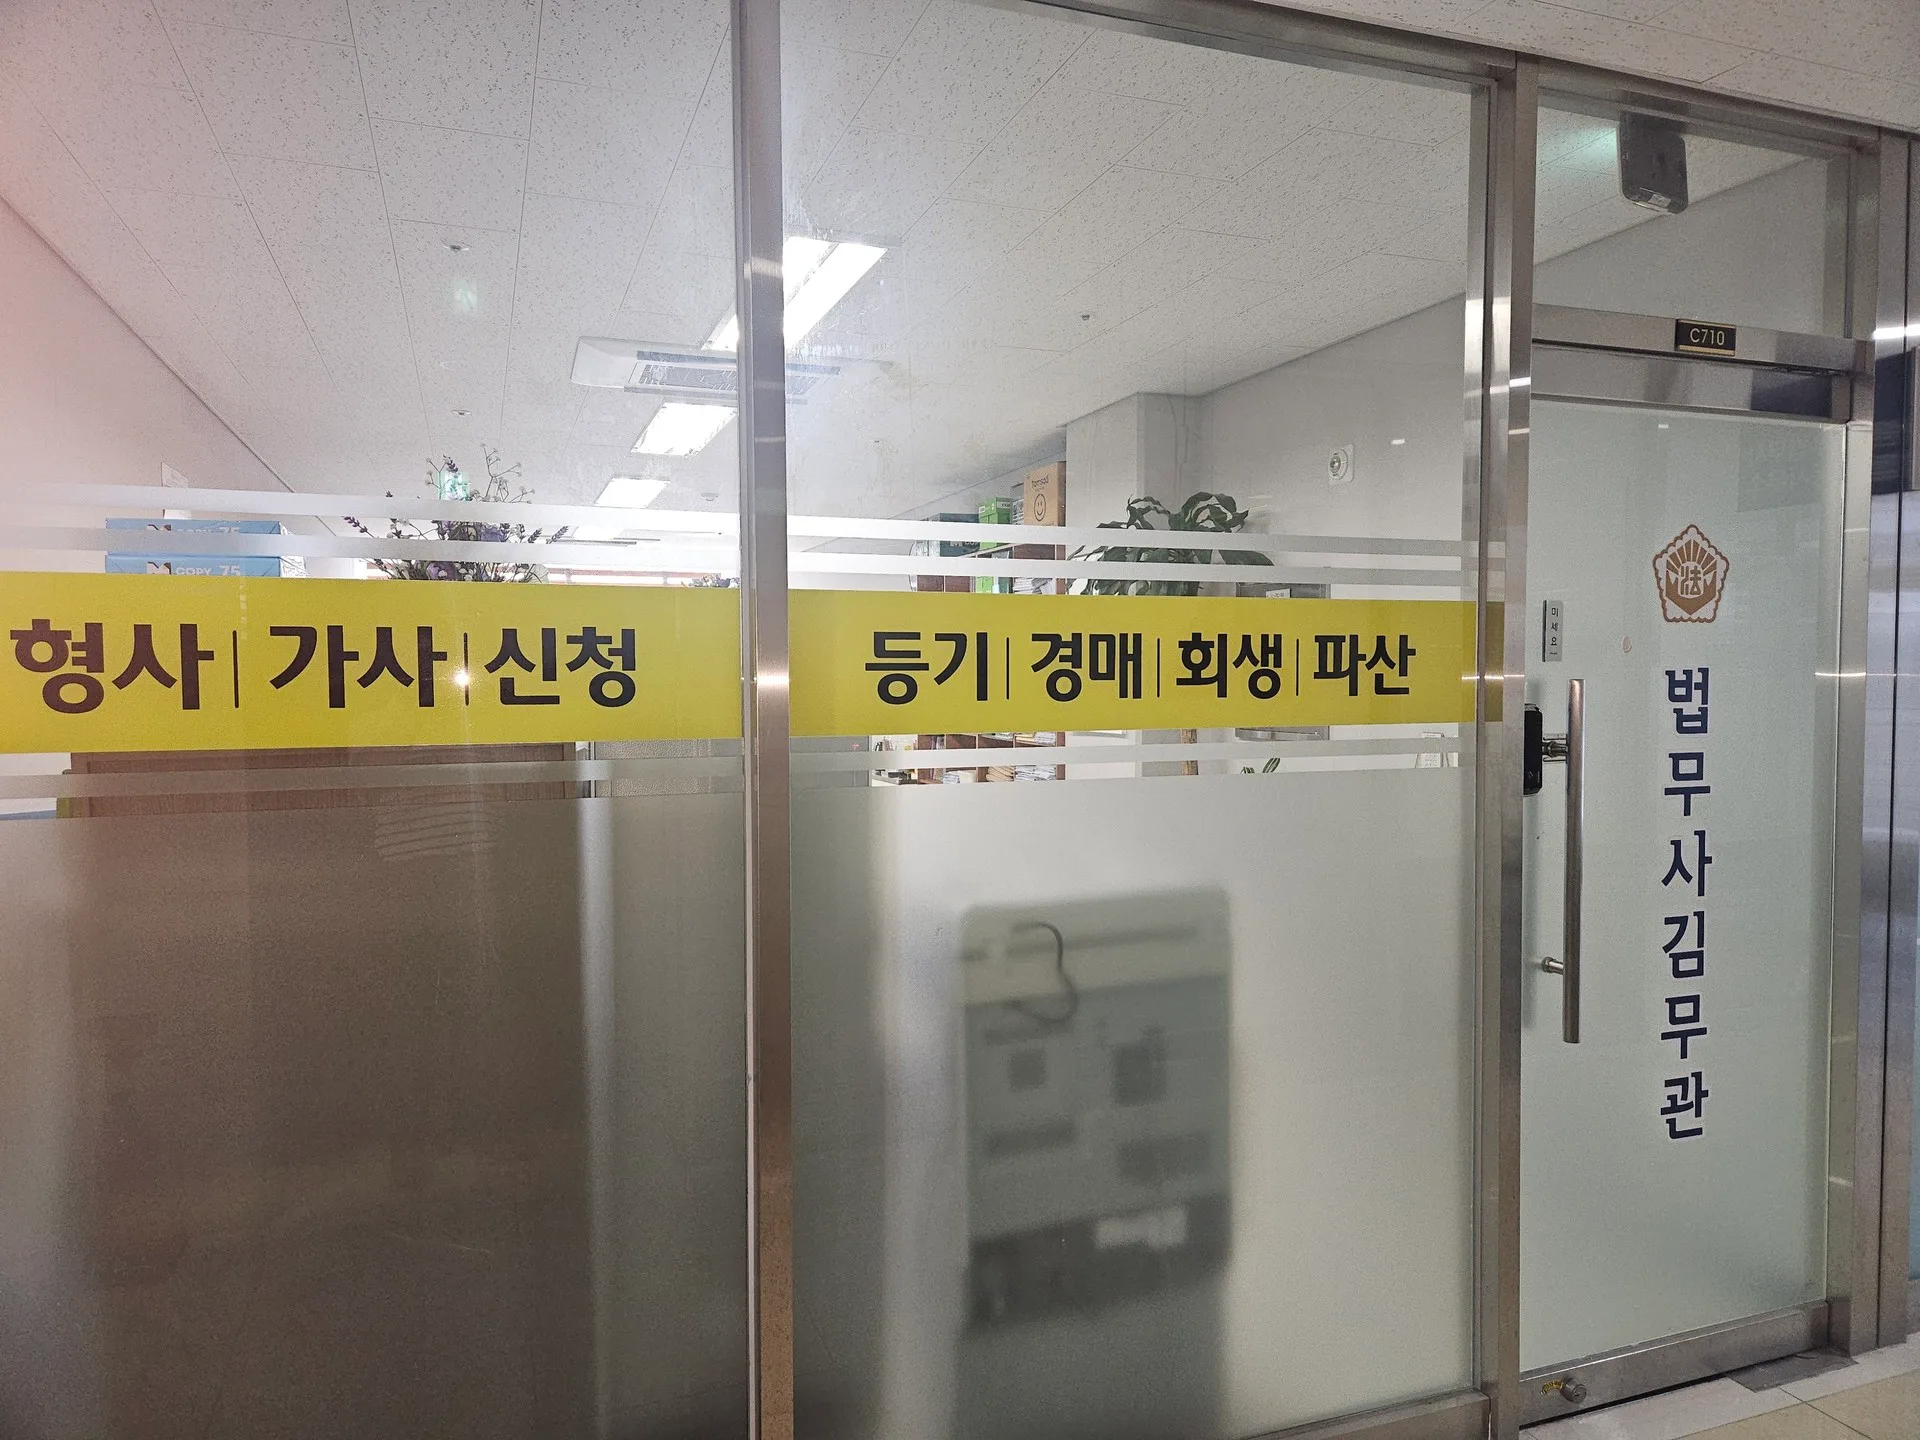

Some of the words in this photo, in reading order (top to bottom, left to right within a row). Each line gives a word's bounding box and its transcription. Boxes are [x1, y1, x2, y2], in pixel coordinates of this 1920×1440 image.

[1690, 328, 1725, 346] C710
[219, 565, 240, 576] 75
[1550, 607, 1559, 646] 미세요
[11, 619, 214, 712] 형사
[269, 626, 446, 708] 가사
[484, 627, 637, 708] 신청
[865, 632, 988, 705] 등기
[1030, 633, 1142, 700] 경매
[1176, 633, 1282, 699] 회생
[1313, 634, 1416, 697] 파산
